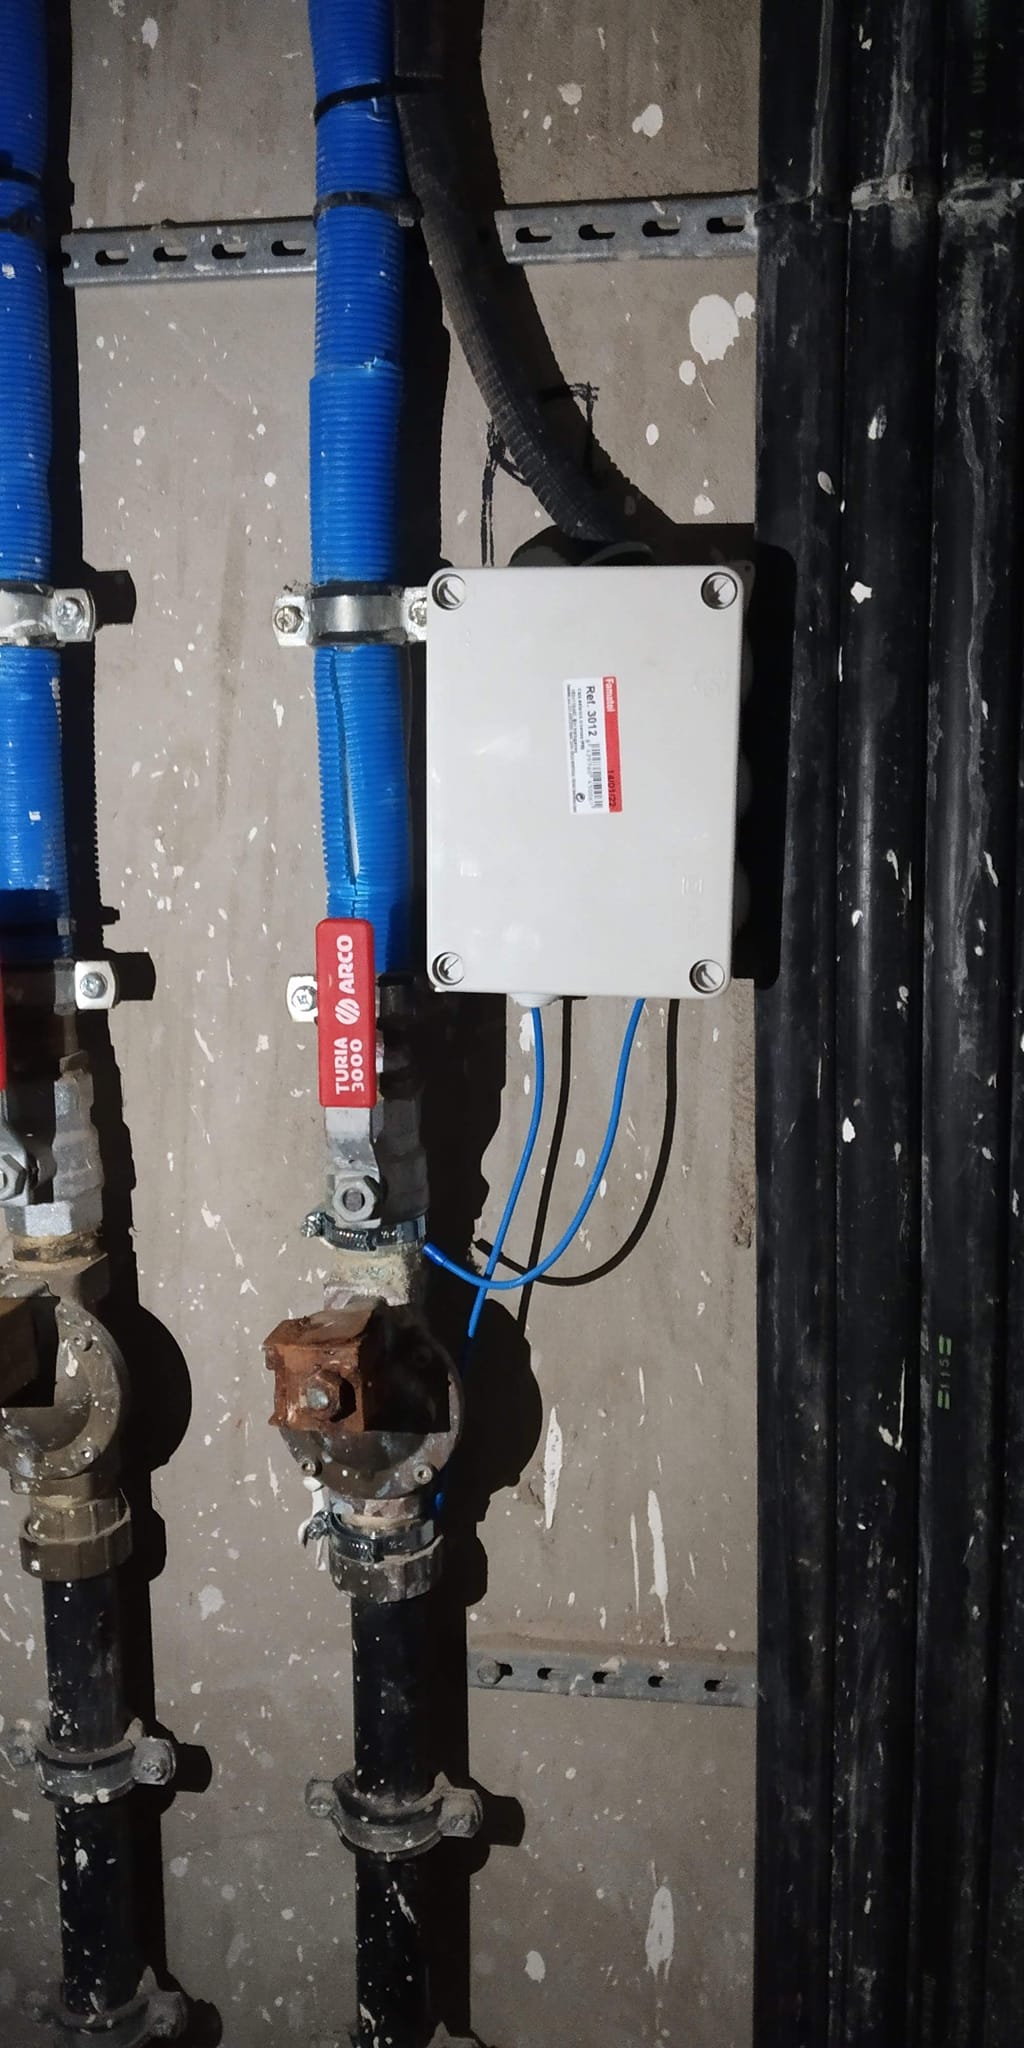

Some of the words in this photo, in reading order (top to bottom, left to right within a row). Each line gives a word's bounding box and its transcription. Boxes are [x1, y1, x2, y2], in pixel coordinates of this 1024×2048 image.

[586, 686, 596, 707] Ref.
[605, 679, 616, 713] Famatel
[587, 711, 598, 736] 3012
[336, 934, 355, 995] ARCO
[334, 1037, 350, 1095] TURIA
[350, 1038, 365, 1093] 3000
